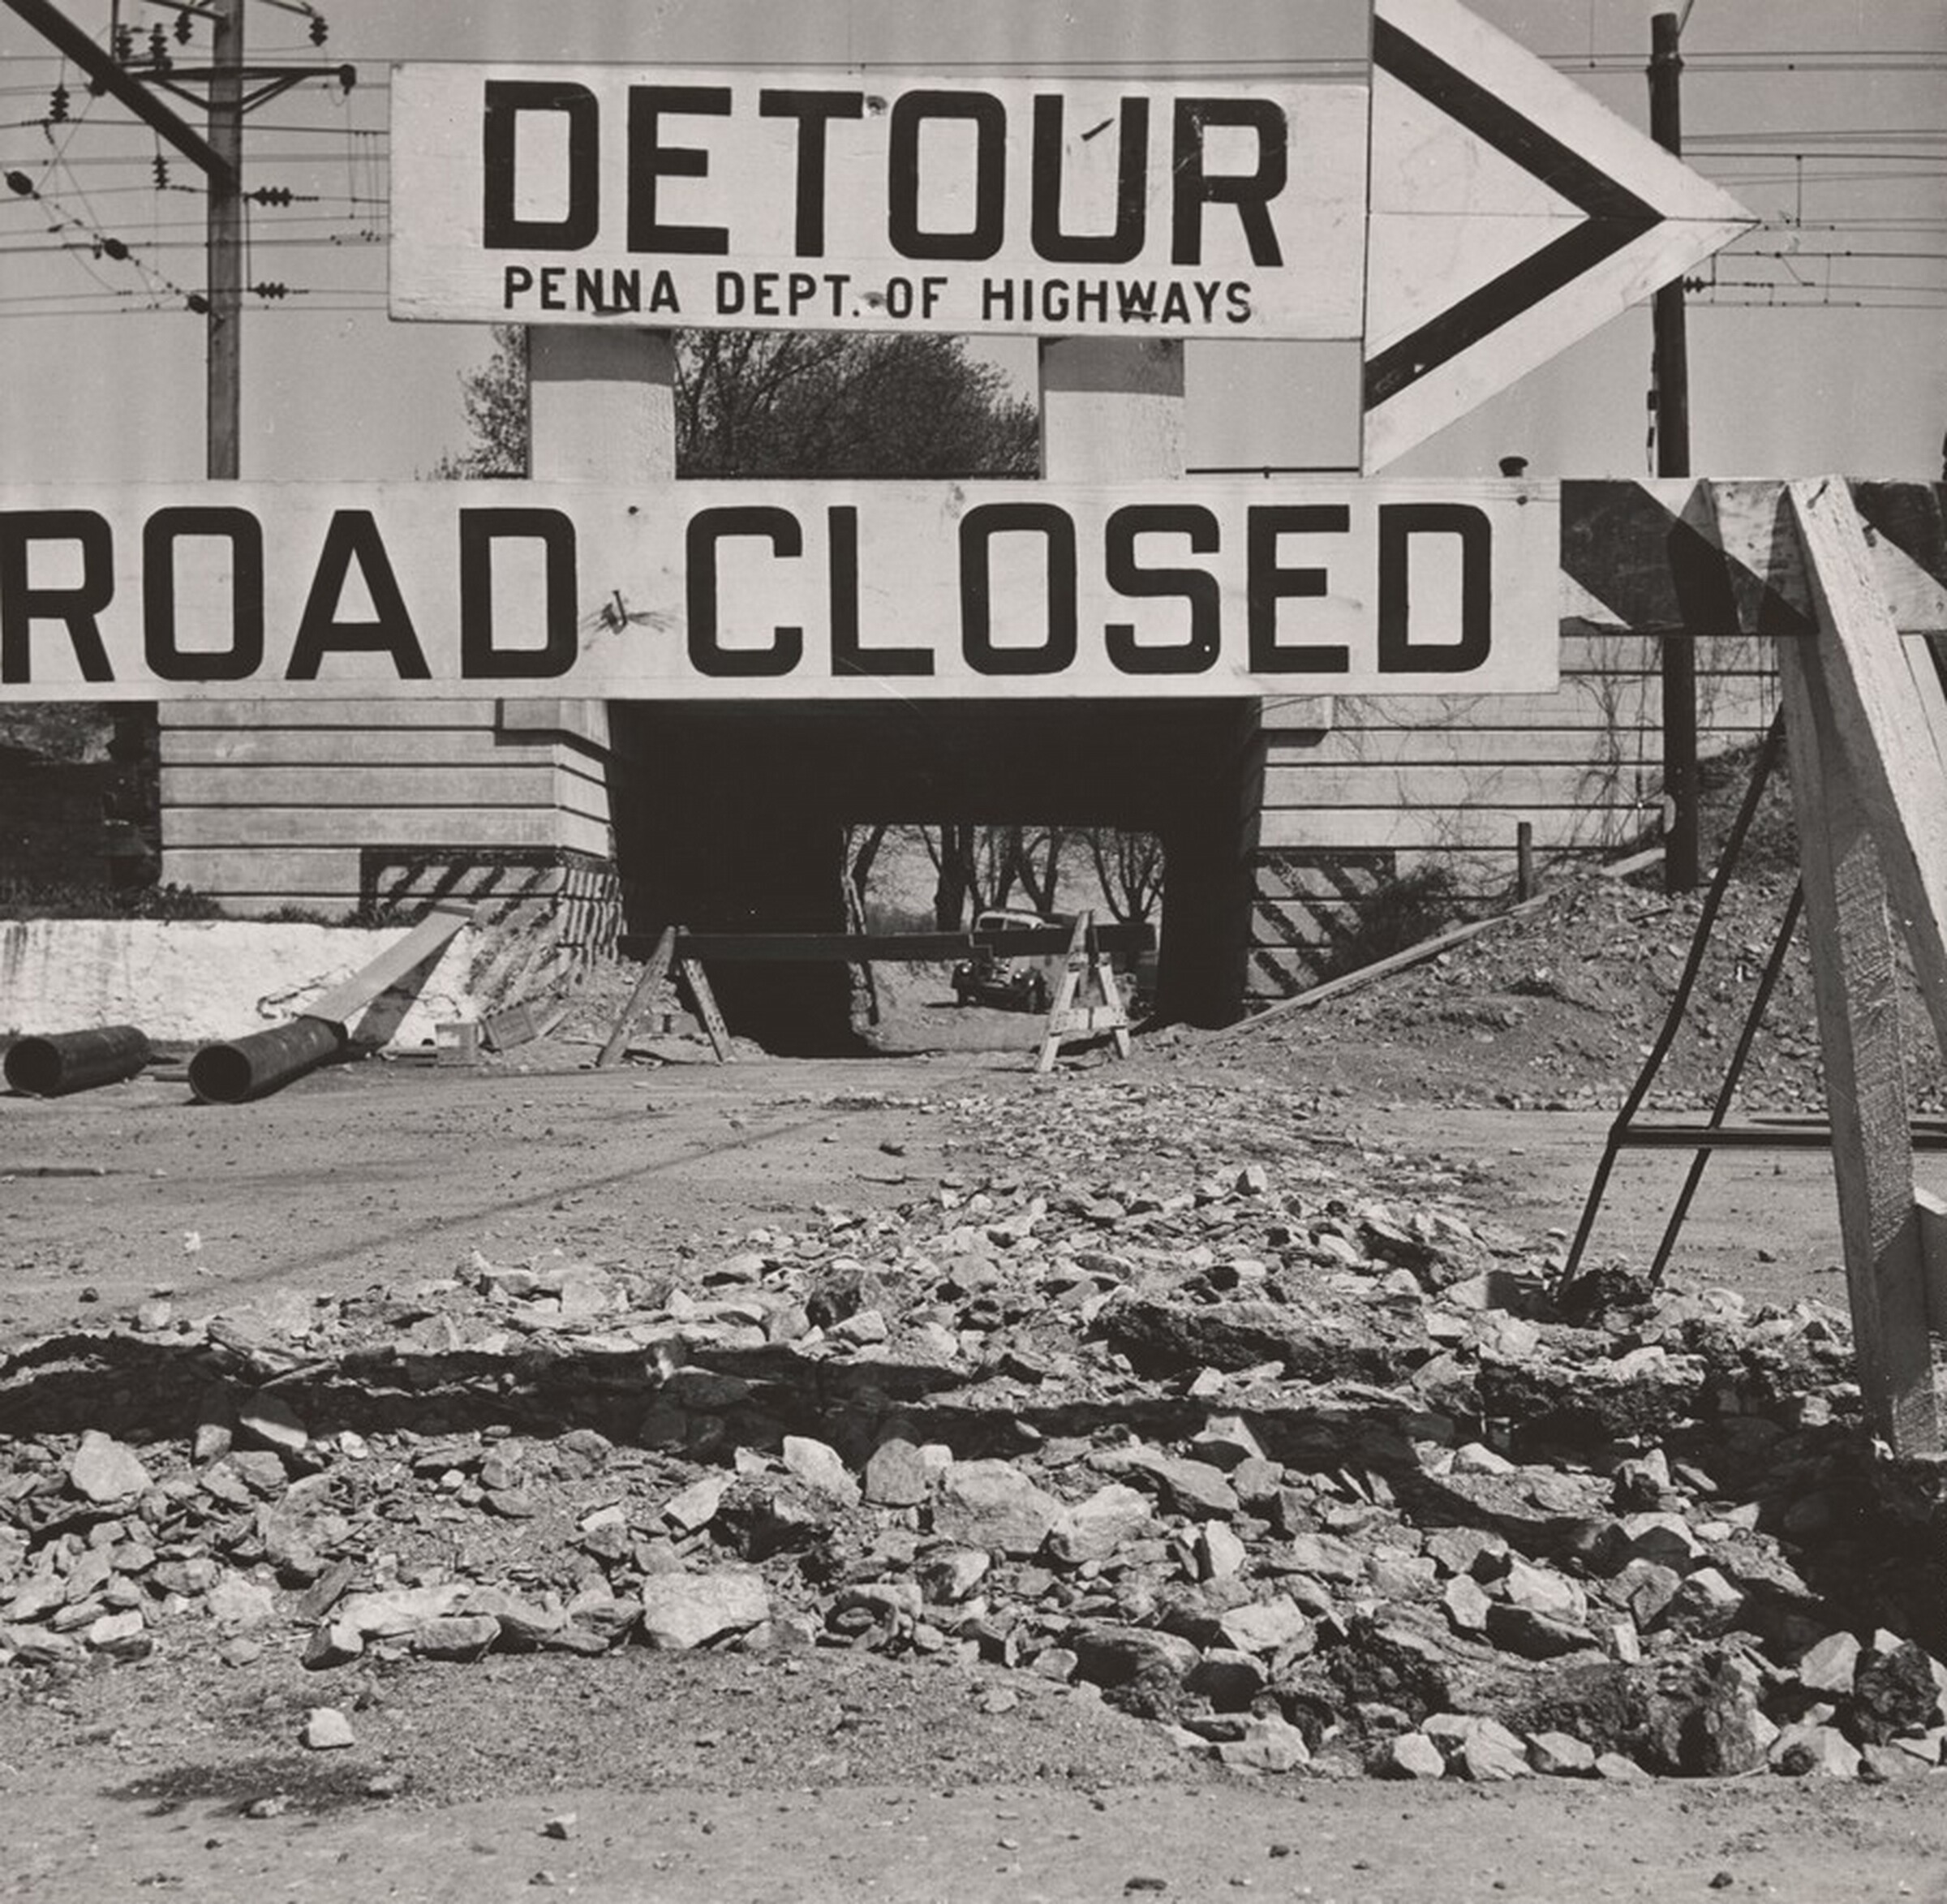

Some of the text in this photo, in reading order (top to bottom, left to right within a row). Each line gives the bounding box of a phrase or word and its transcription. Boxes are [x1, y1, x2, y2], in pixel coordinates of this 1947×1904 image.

[484, 80, 1288, 267] DETOUR
[504, 266, 1251, 324] PENNA DEPT. OF HIGHWAYS
[0, 502, 1492, 684] ROAD CLOSED
